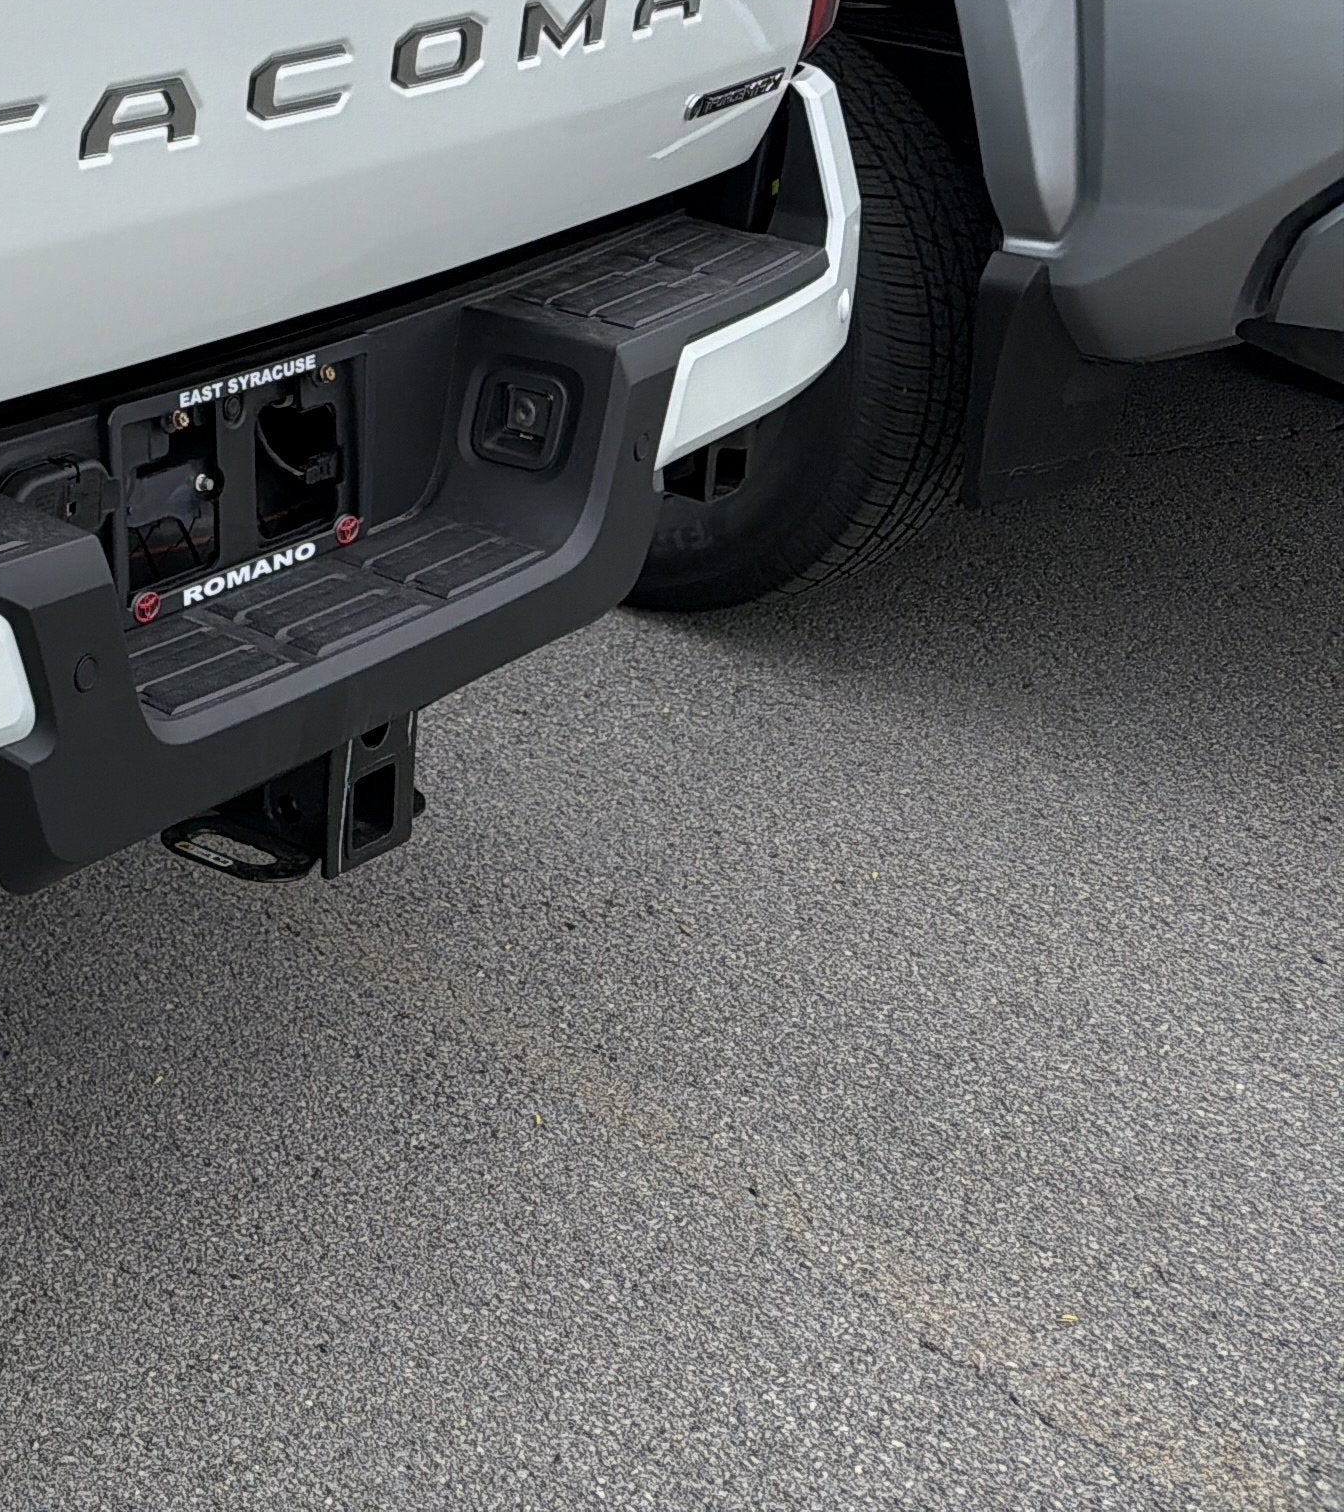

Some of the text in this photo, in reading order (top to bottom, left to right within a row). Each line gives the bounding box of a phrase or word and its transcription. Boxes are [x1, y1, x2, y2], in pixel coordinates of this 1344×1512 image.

[179, 354, 316, 408] EAST SYRACUSE
[183, 542, 316, 606] ROMANO
